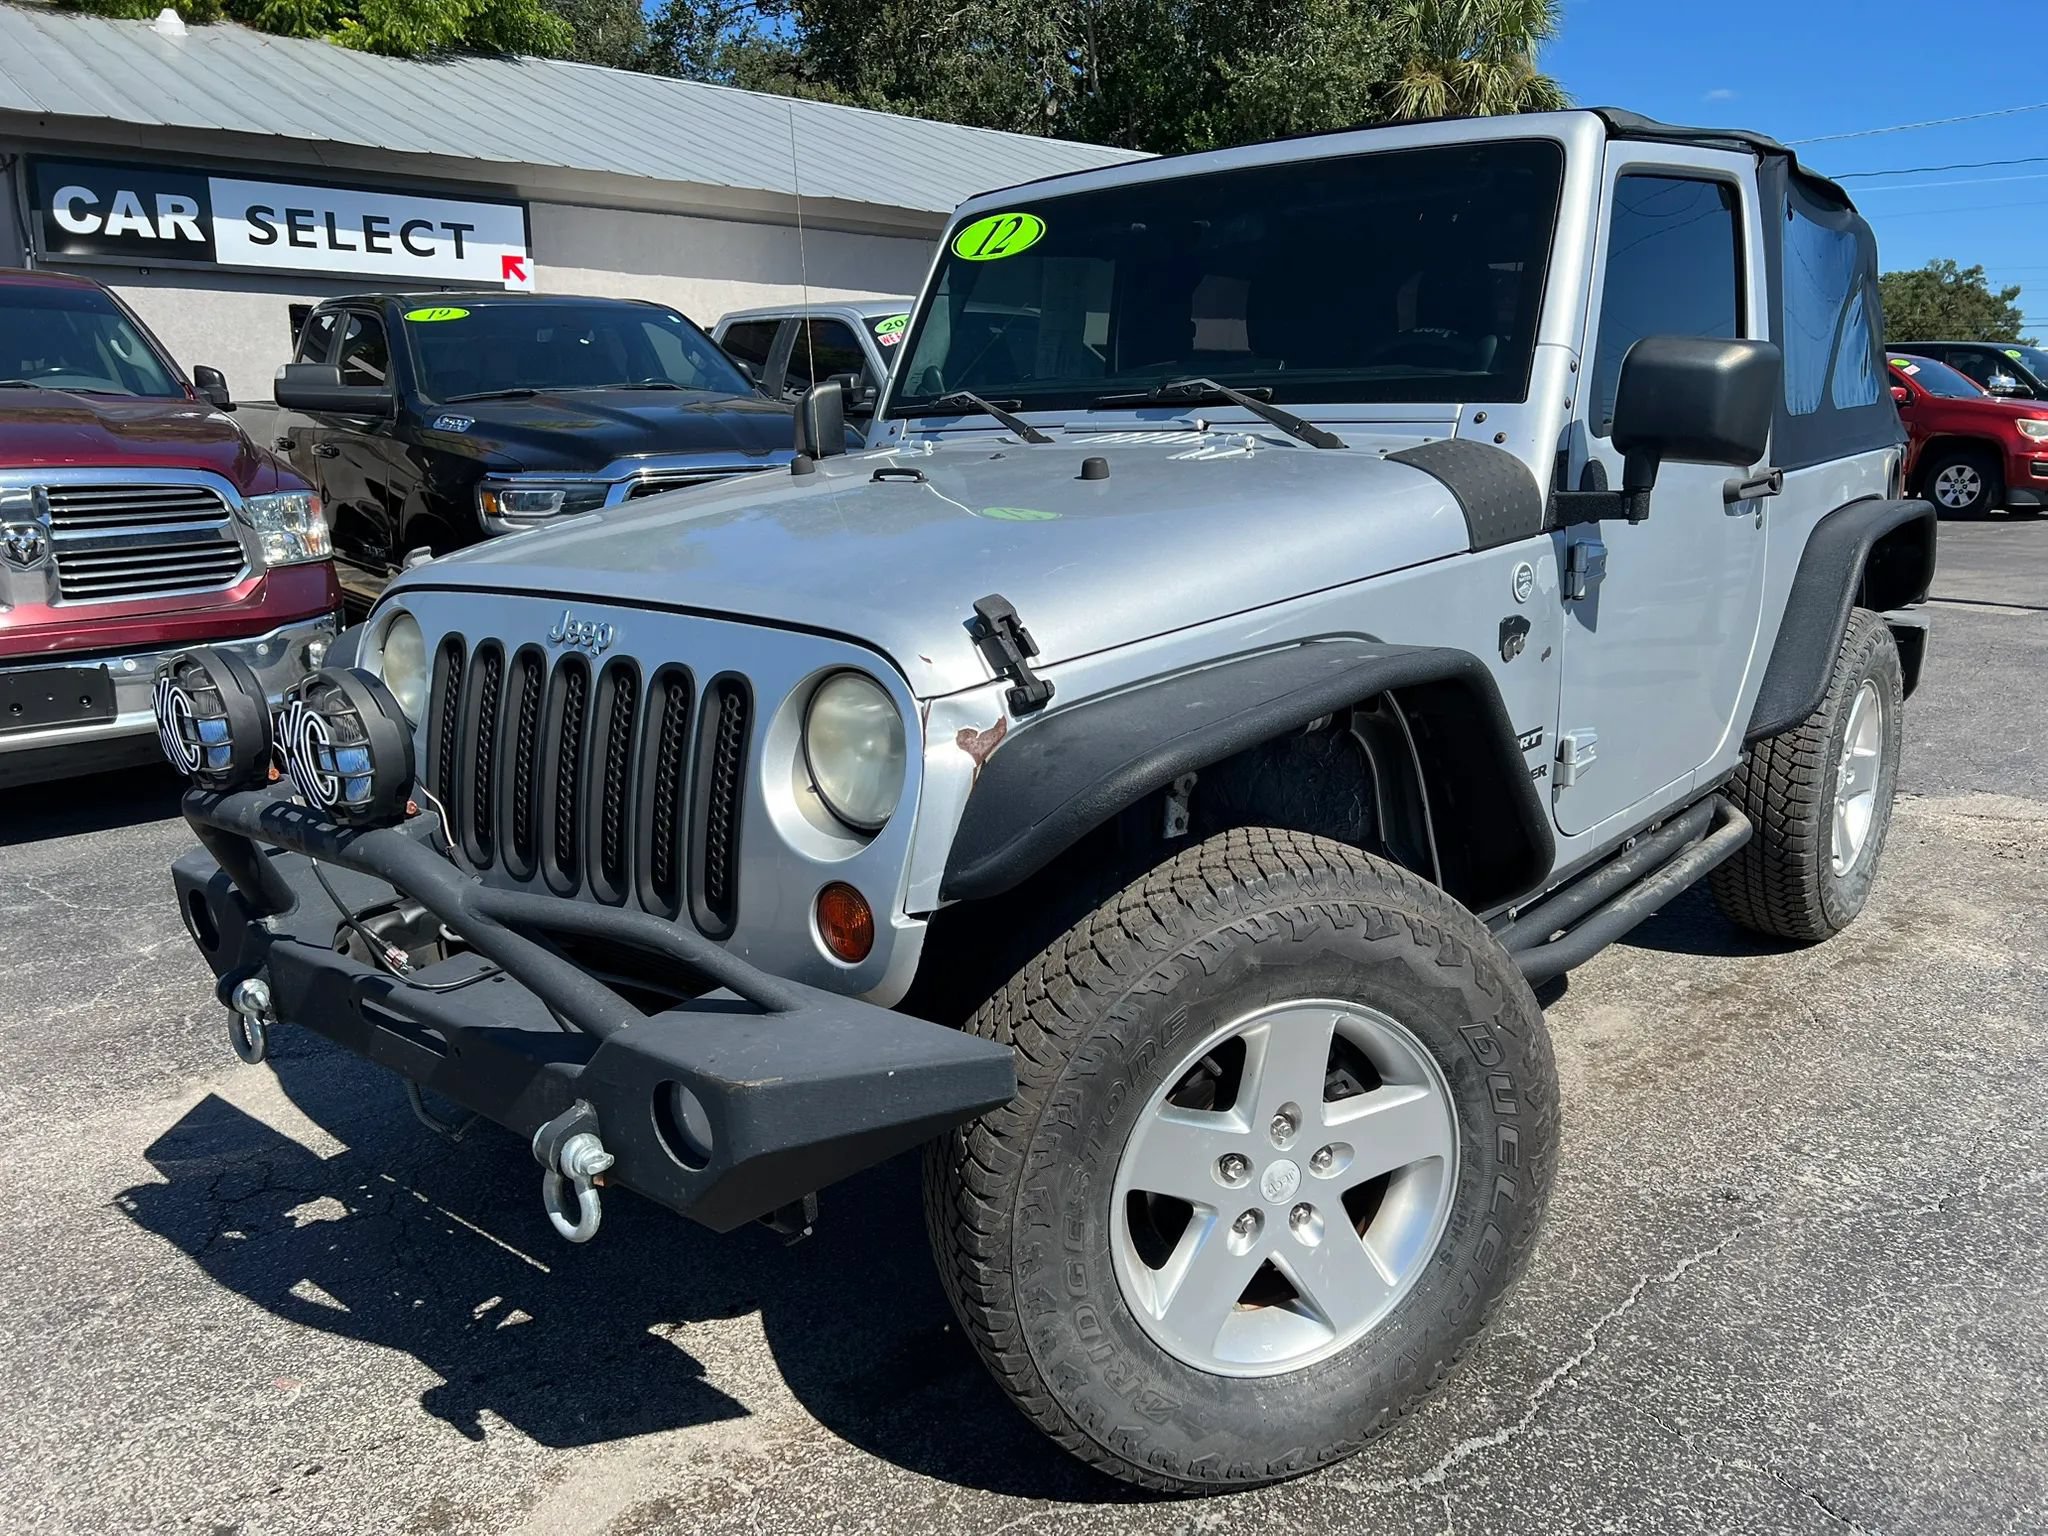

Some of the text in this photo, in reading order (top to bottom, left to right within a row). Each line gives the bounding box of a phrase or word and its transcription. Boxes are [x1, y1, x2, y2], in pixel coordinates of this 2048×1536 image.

[53, 185, 475, 260] CAR SELECT
[970, 216, 1023, 257] 12
[426, 309, 450, 320] 19
[883, 317, 910, 331] 20
[548, 610, 613, 656] Jeep
[279, 701, 339, 810] KC
[1450, 1020, 1521, 1327] DUELER
